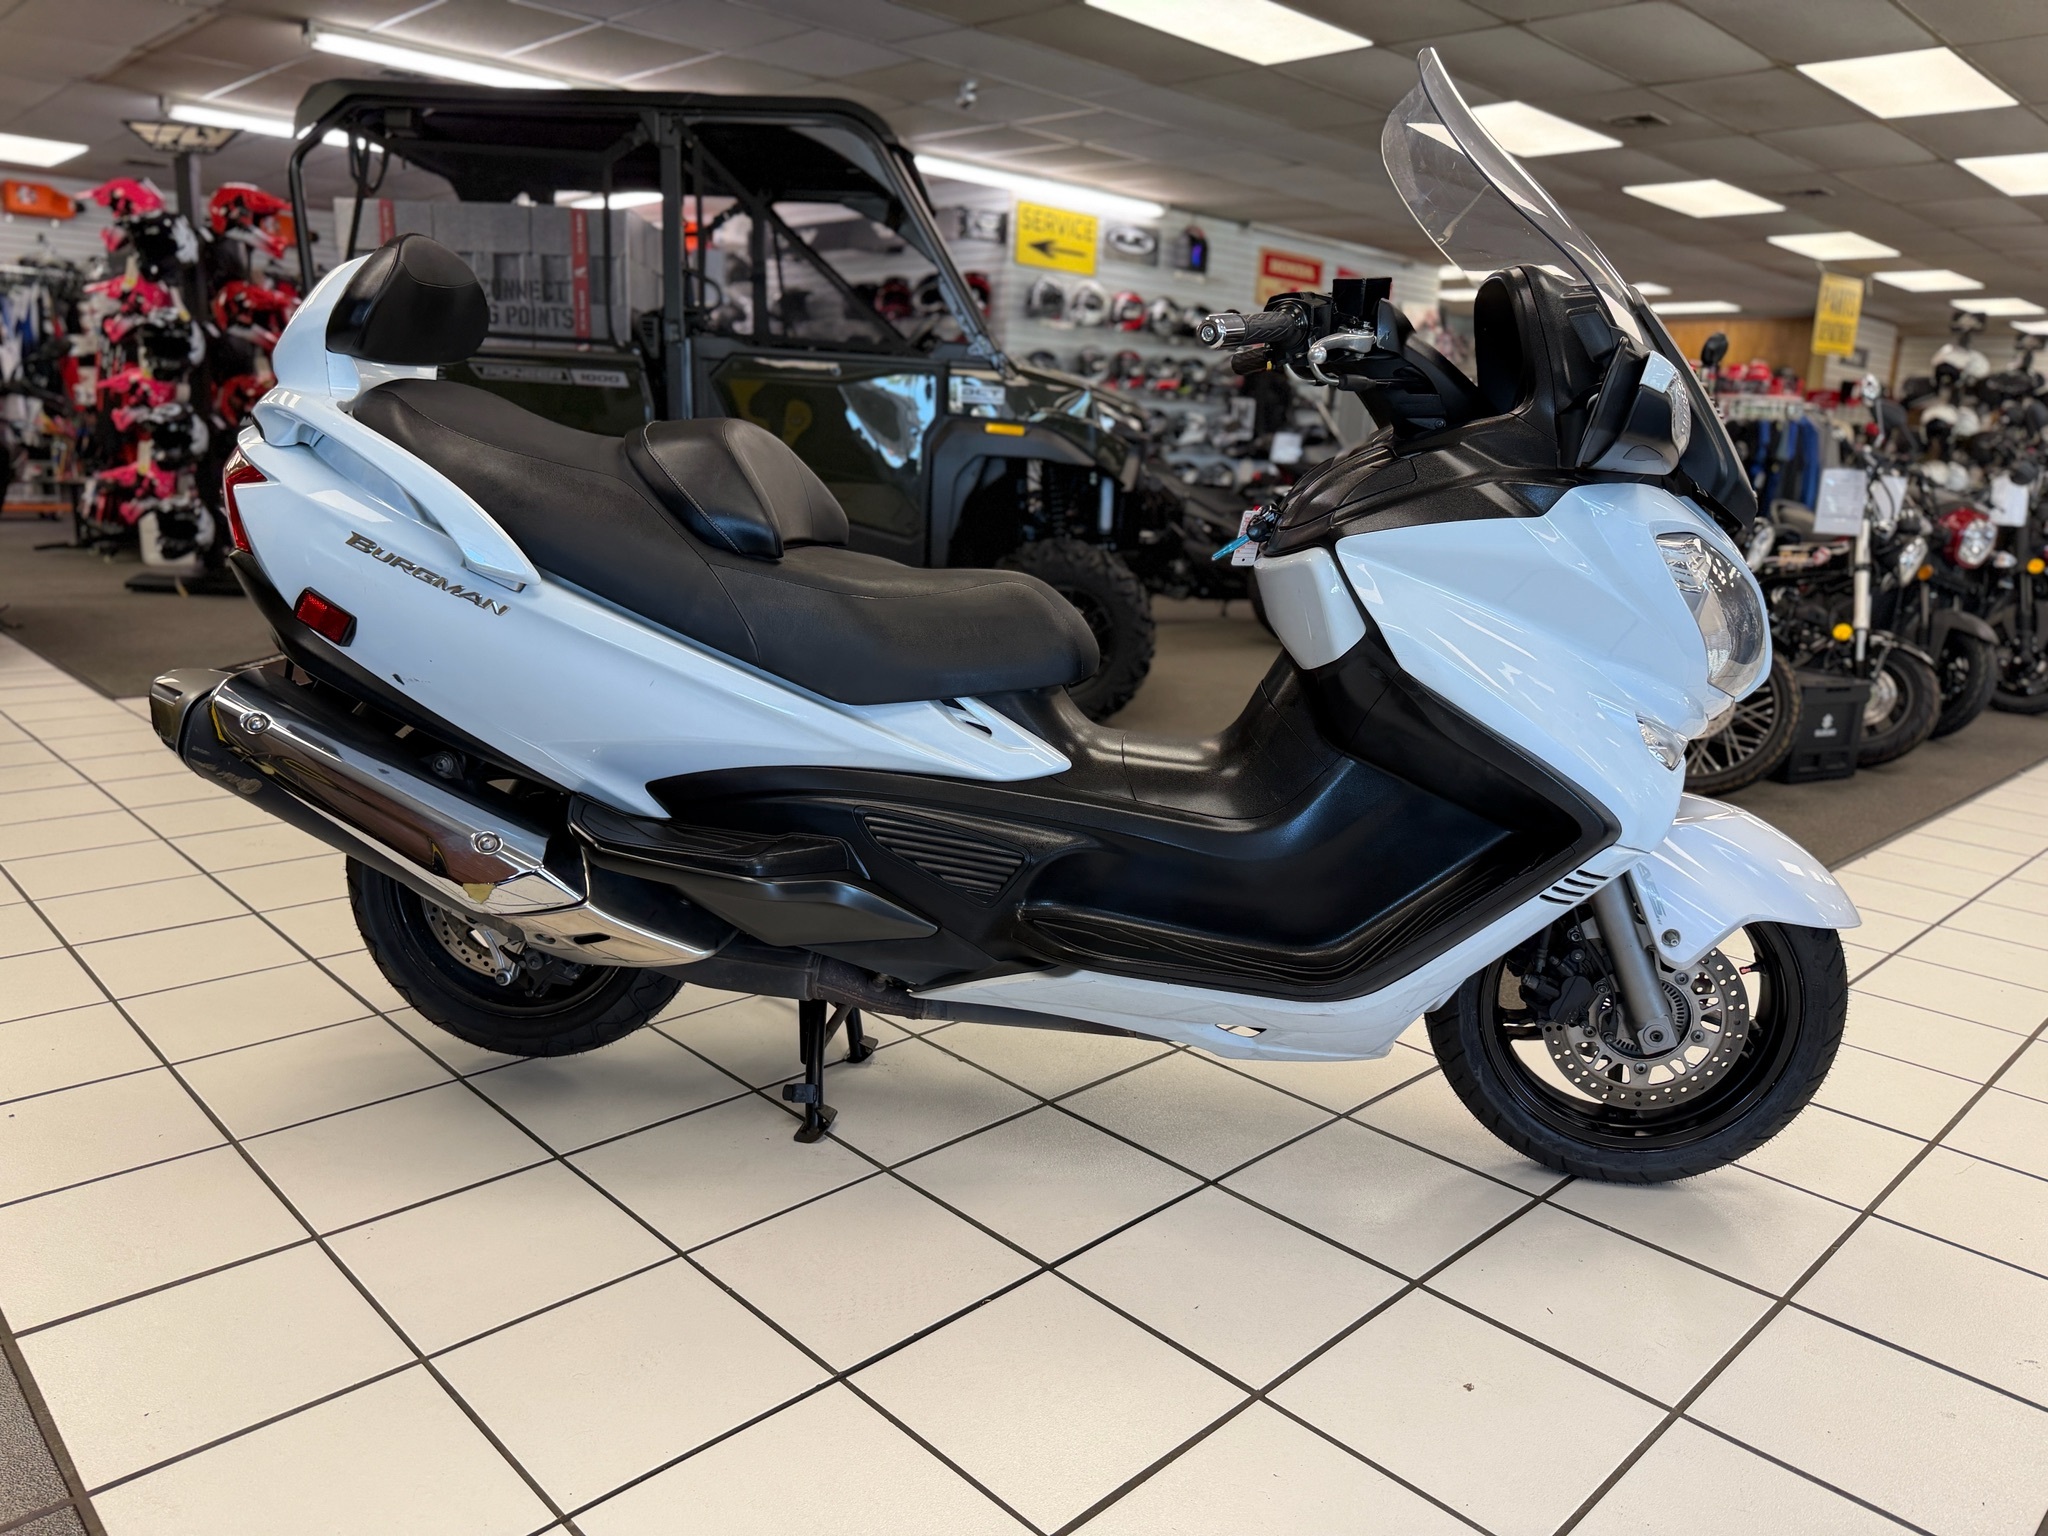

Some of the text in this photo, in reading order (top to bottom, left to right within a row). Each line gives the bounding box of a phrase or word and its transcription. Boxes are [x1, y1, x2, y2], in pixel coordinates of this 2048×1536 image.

[1020, 207, 1094, 243] SERVICE
[506, 305, 575, 330] POINTS
[580, 372, 621, 384] 1000
[345, 530, 511, 617] BURGMAN
